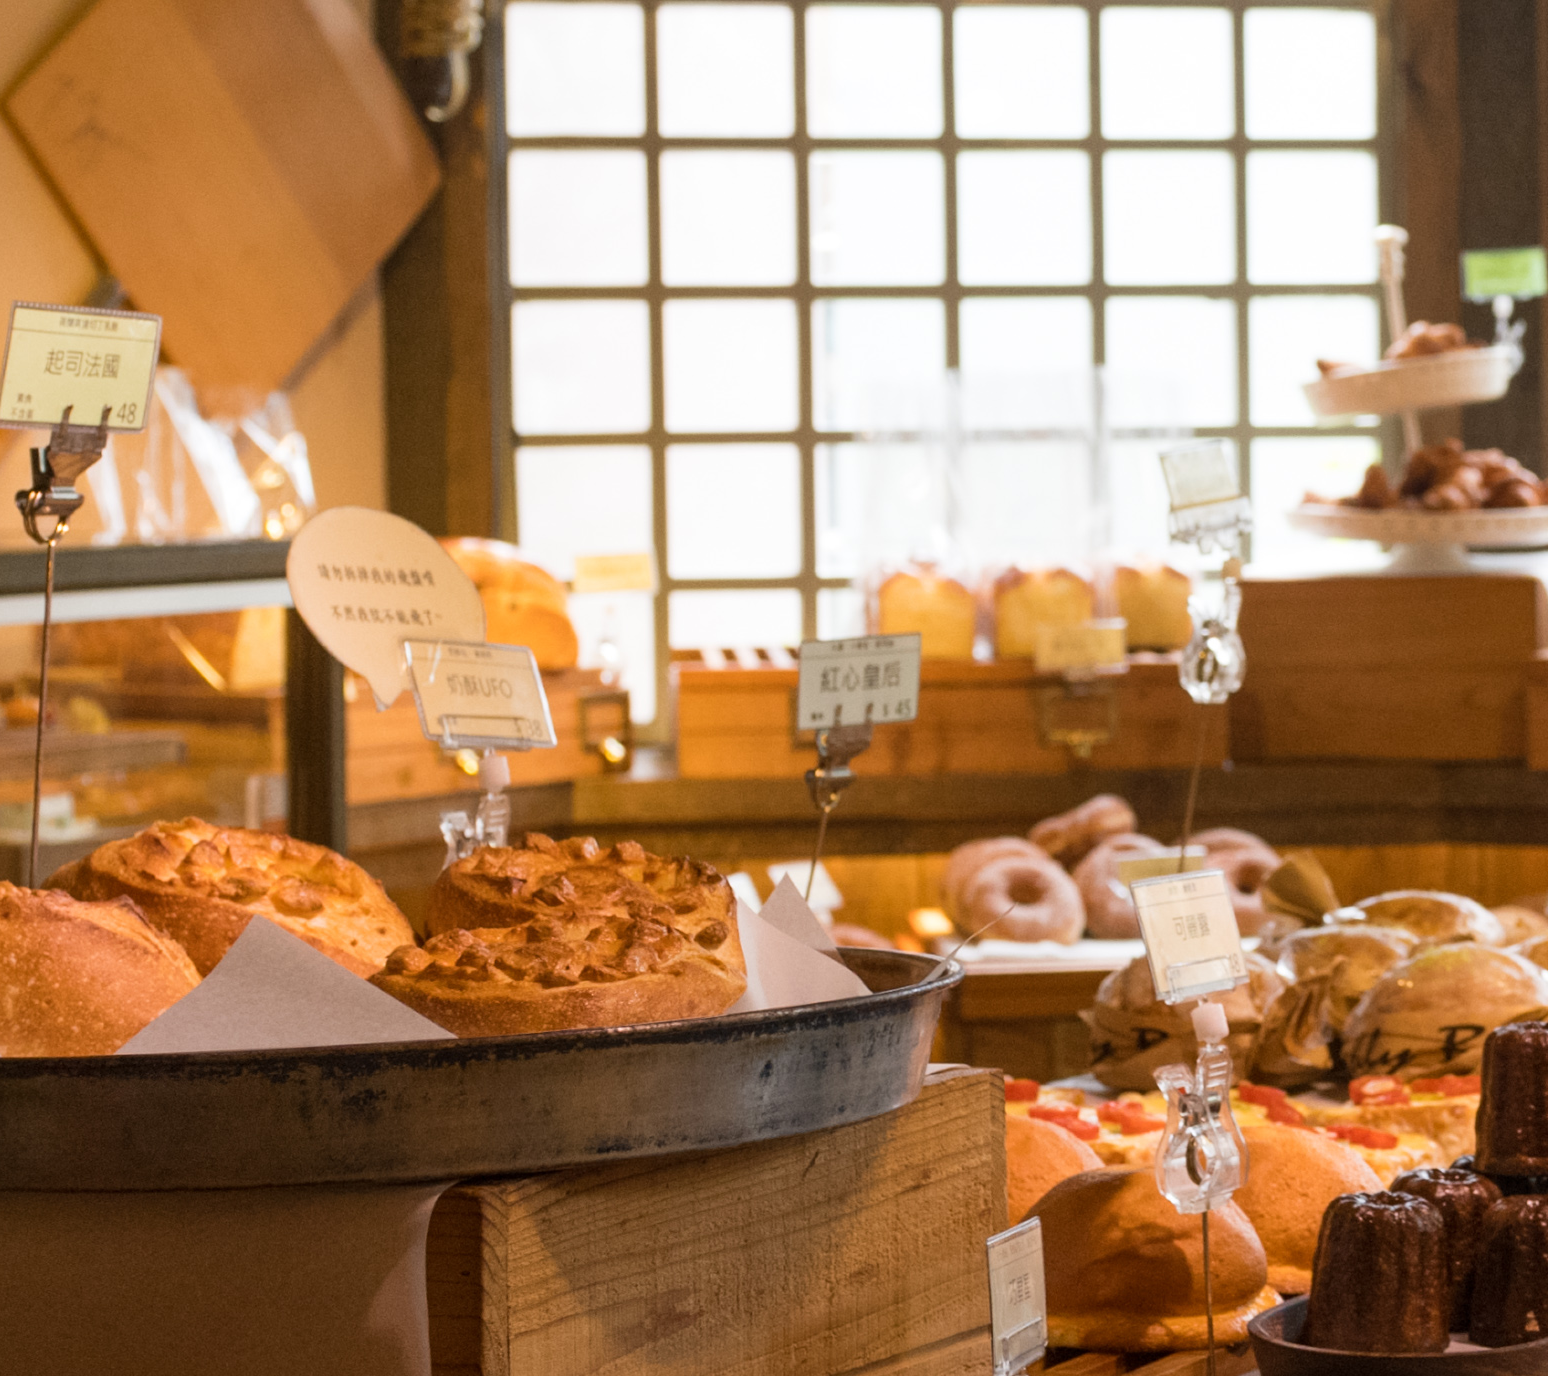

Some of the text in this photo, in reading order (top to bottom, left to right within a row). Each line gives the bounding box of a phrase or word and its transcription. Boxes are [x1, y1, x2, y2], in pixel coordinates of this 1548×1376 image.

[44, 349, 122, 379] 起司法國
[116, 402, 138, 425] 48
[446, 673, 514, 700] 奶酥UFO
